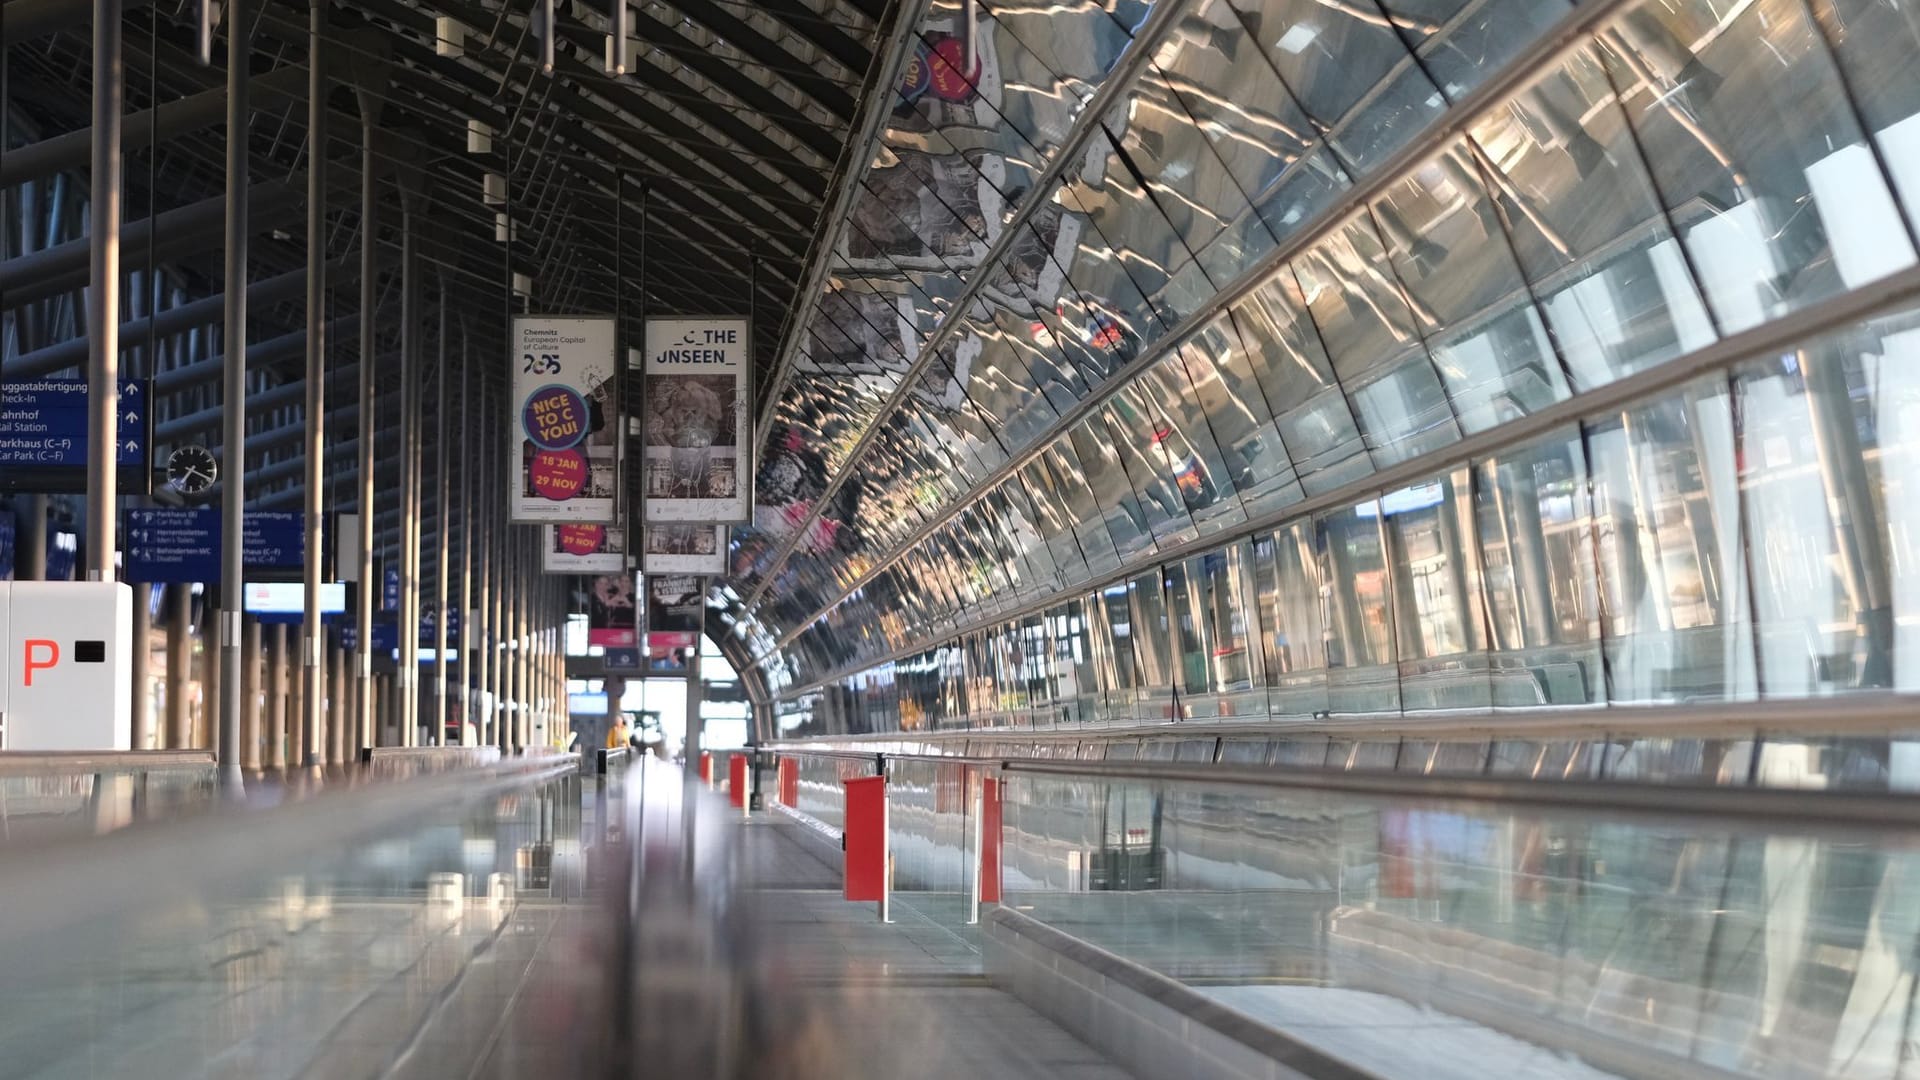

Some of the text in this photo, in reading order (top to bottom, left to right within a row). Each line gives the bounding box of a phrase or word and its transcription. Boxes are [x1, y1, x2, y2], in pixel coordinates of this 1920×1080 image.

[1, 382, 88, 393] uggastabfertigung
[1, 394, 37, 403] heck-In
[532, 394, 570, 414] NICE
[1, 410, 39, 420] ahnhof
[536, 408, 574, 427] TO C
[15, 423, 48, 432] Station
[540, 421, 578, 441] YOU!
[0, 439, 42, 449] arkhaus
[14, 451, 34, 460] Park
[542, 456, 579, 470] 18 JAN
[536, 475, 578, 490] 29 NOV
[575, 538, 596, 547] NOV
[23, 639, 60, 687] P
